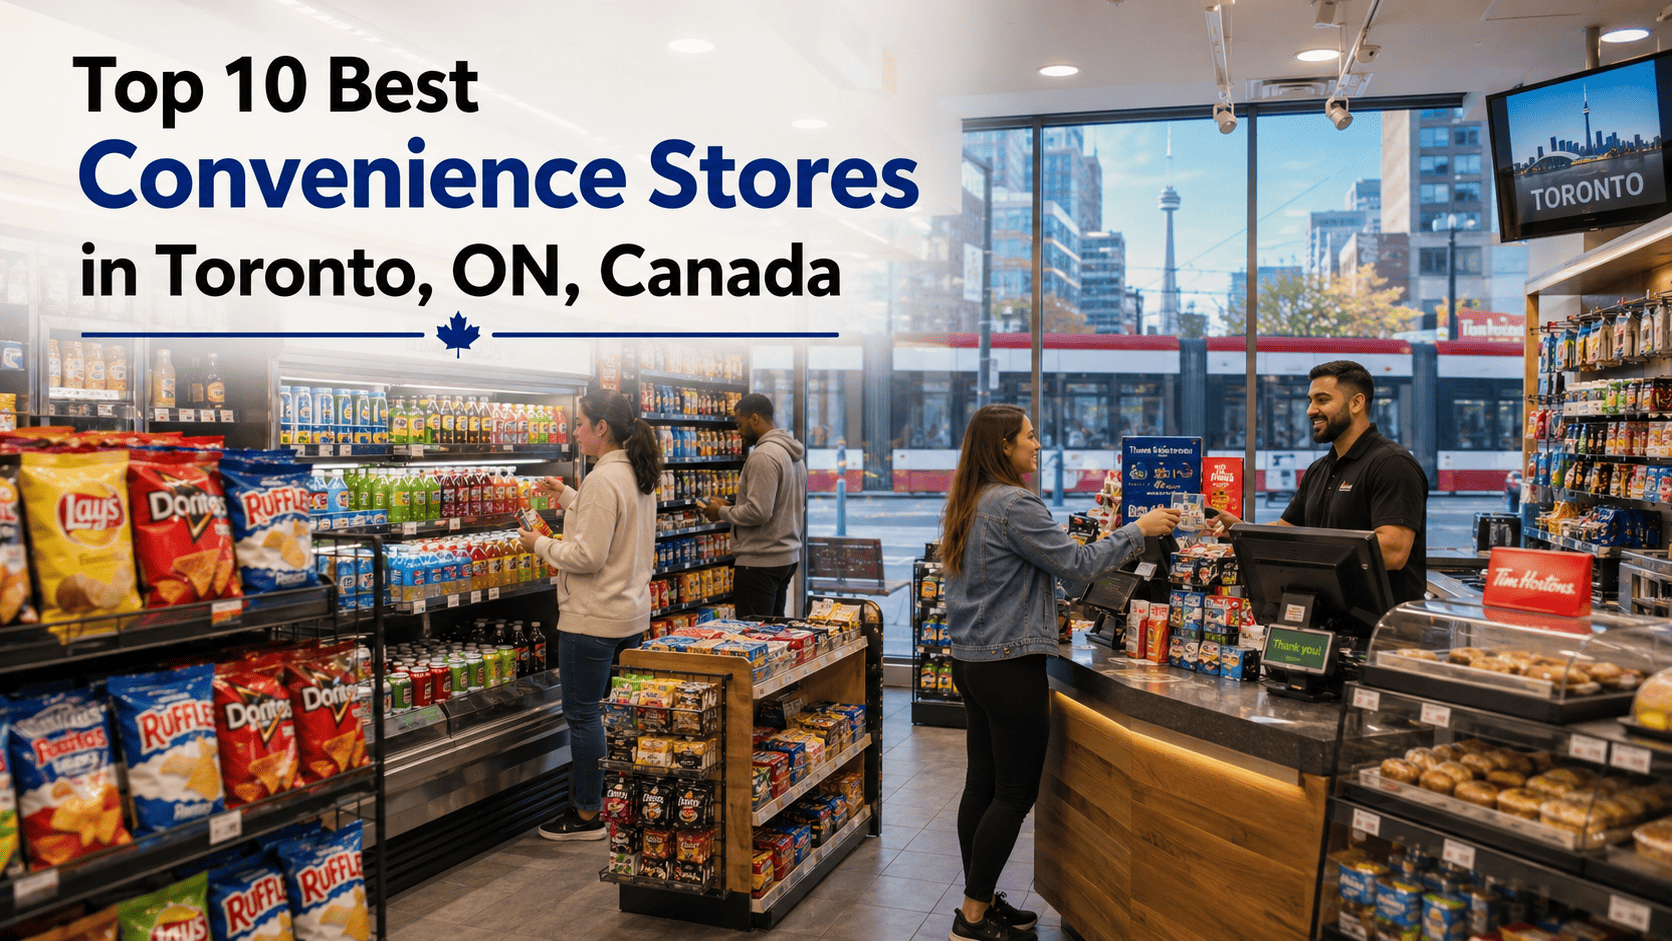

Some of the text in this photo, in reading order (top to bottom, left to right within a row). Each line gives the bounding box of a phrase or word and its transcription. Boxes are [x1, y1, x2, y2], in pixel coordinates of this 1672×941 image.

[1531, 172, 1644, 211] TORONTO
[149, 491, 228, 521] Doritos
[1493, 567, 1519, 588] Tim
[1273, 637, 1300, 653] Thank
[226, 698, 293, 730] Doritos
